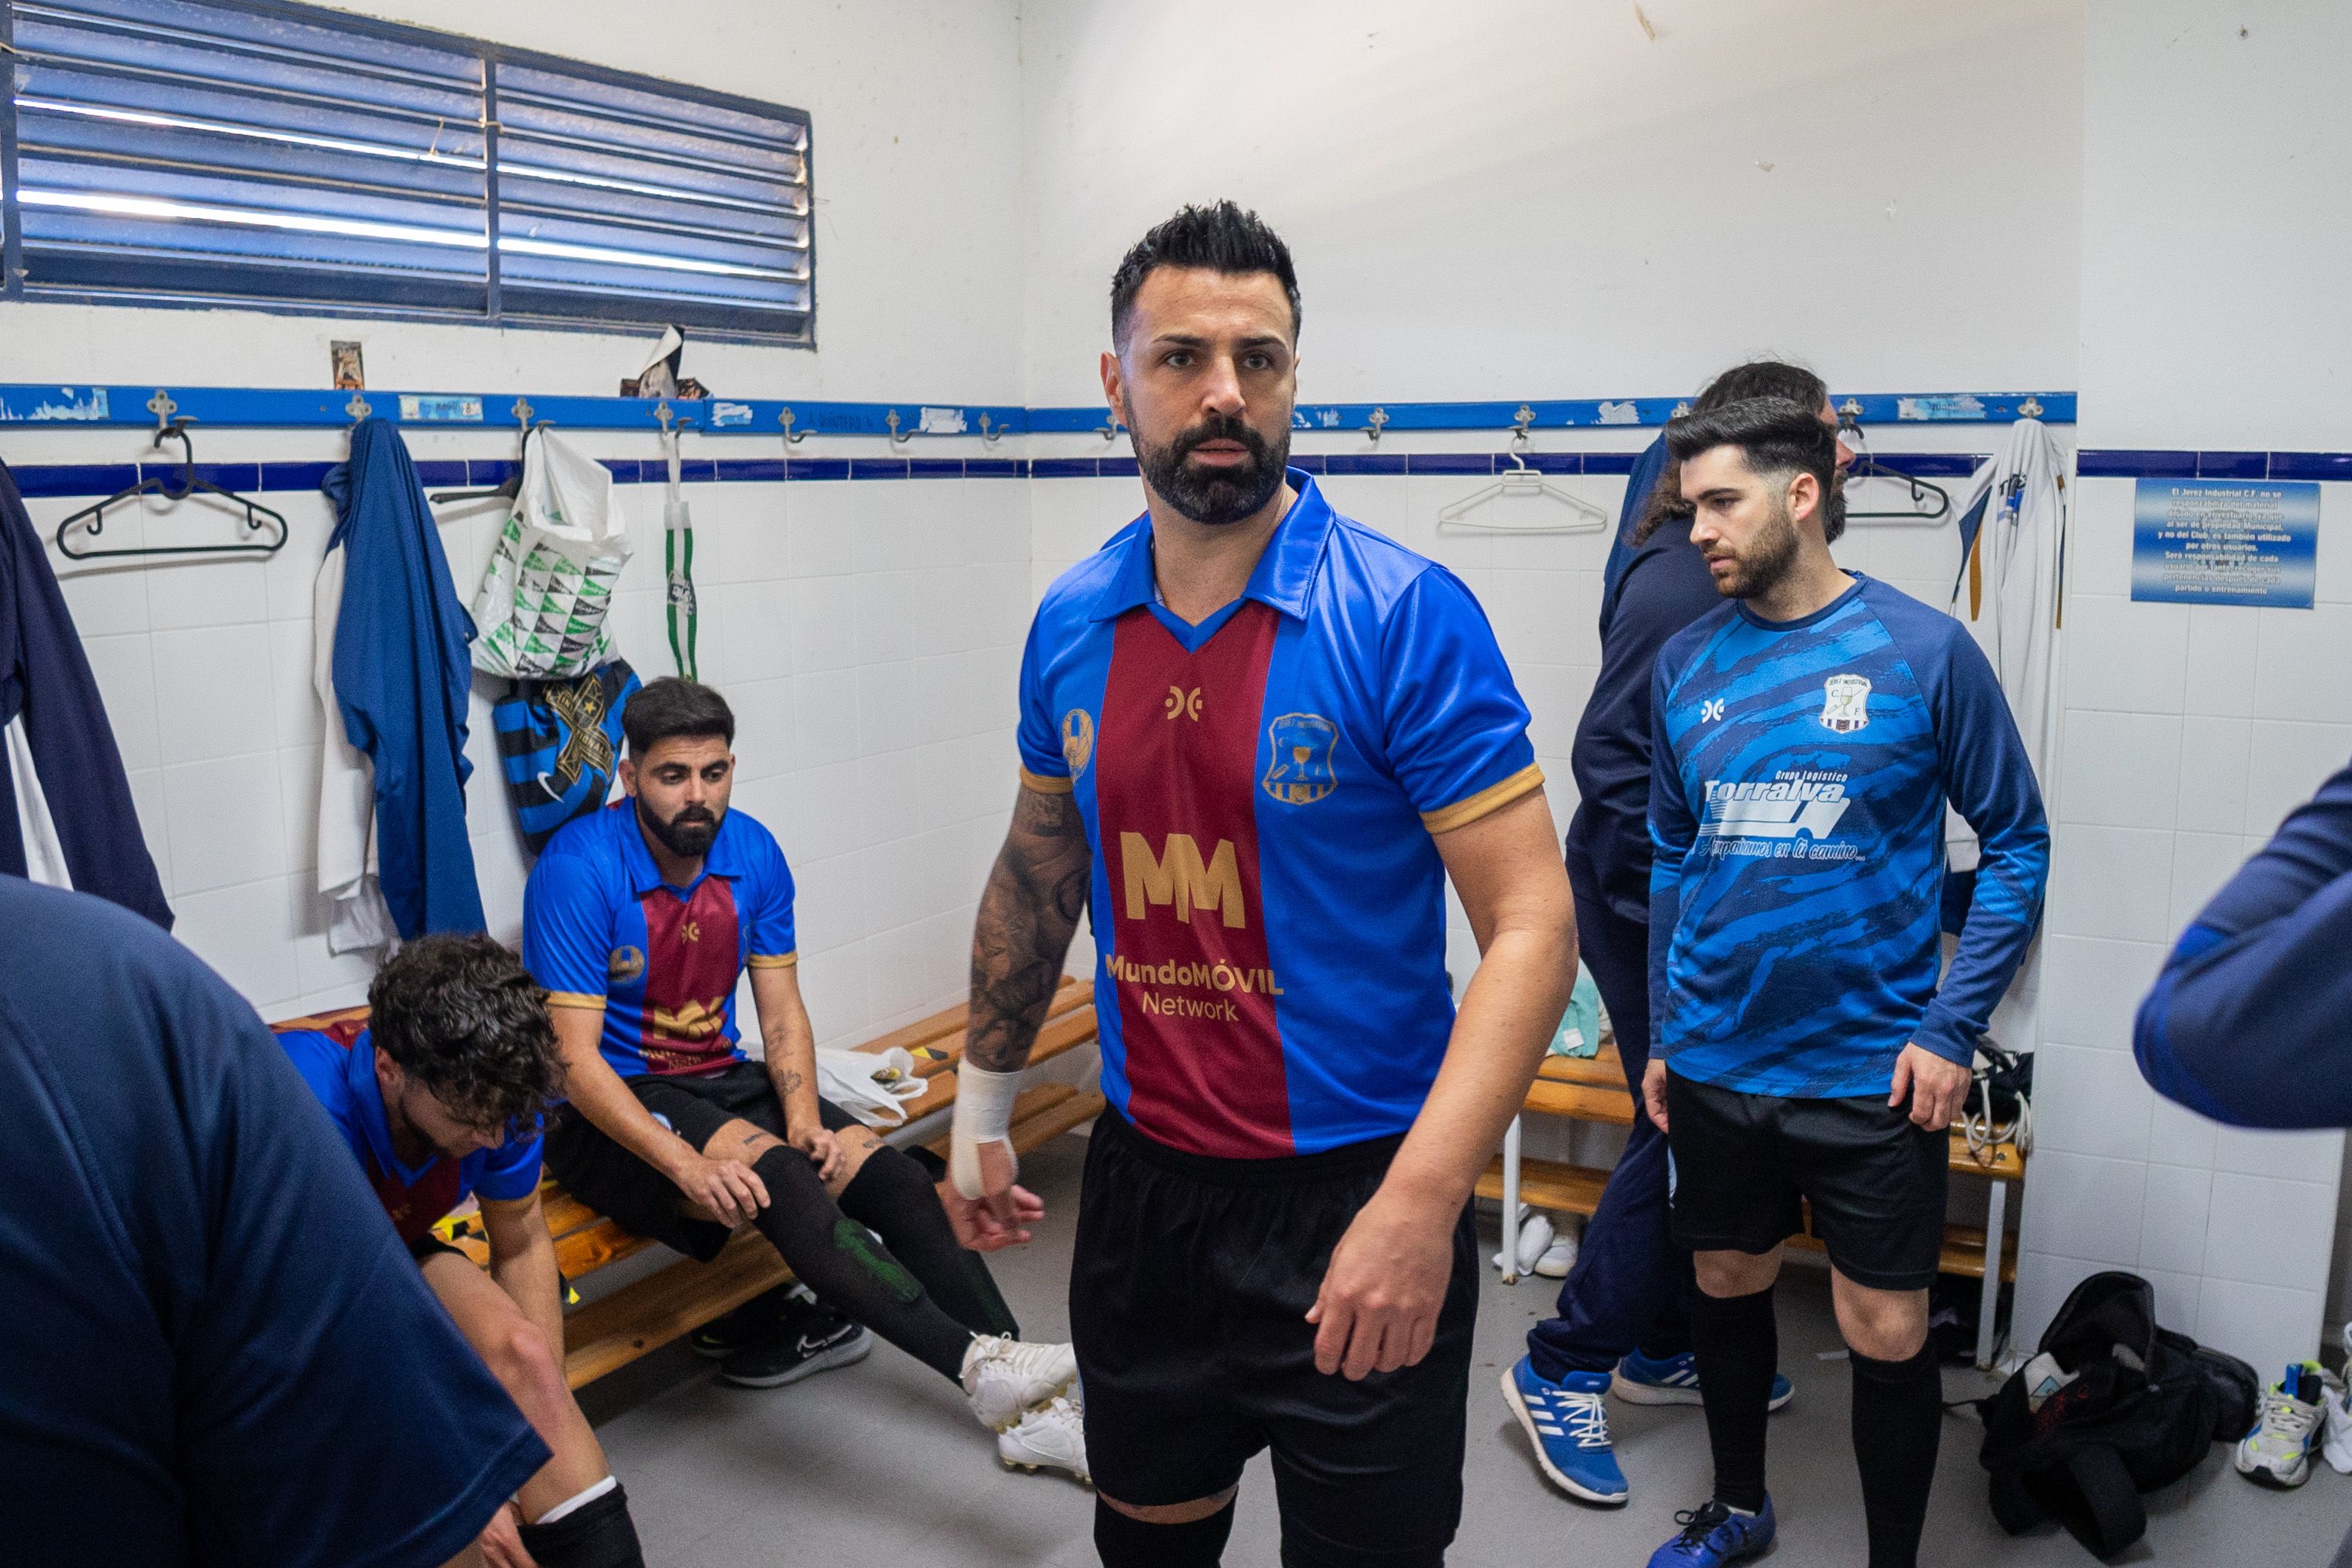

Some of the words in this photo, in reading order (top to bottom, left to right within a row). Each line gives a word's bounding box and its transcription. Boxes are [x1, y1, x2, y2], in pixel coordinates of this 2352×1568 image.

[2205, 489, 2241, 497] Industrial
[2167, 510, 2193, 518] dejado
[2202, 521, 2241, 530] propiedad
[2244, 522, 2283, 532] Municipal,
[2158, 531, 2163, 539] y
[2224, 532, 2255, 541] también
[2257, 533, 2292, 542] utilizado
[2185, 542, 2199, 551] por
[2185, 553, 2245, 561] responsabilidad
[2247, 554, 2257, 563] de
[2234, 566, 2264, 575] recoger
[2163, 573, 2212, 581] pertenencias
[2175, 585, 2202, 593] partido
[2212, 586, 2268, 594] entrenamiento
[1775, 770, 1801, 781] Grupo
[1801, 770, 1848, 782] Logístico
[1704, 779, 1846, 802] Torralva
[1773, 842, 1792, 858] en
[1120, 830, 1245, 929] MM
[1105, 953, 1285, 996] MundoMÓVIL
[1141, 991, 1239, 1021] Network
